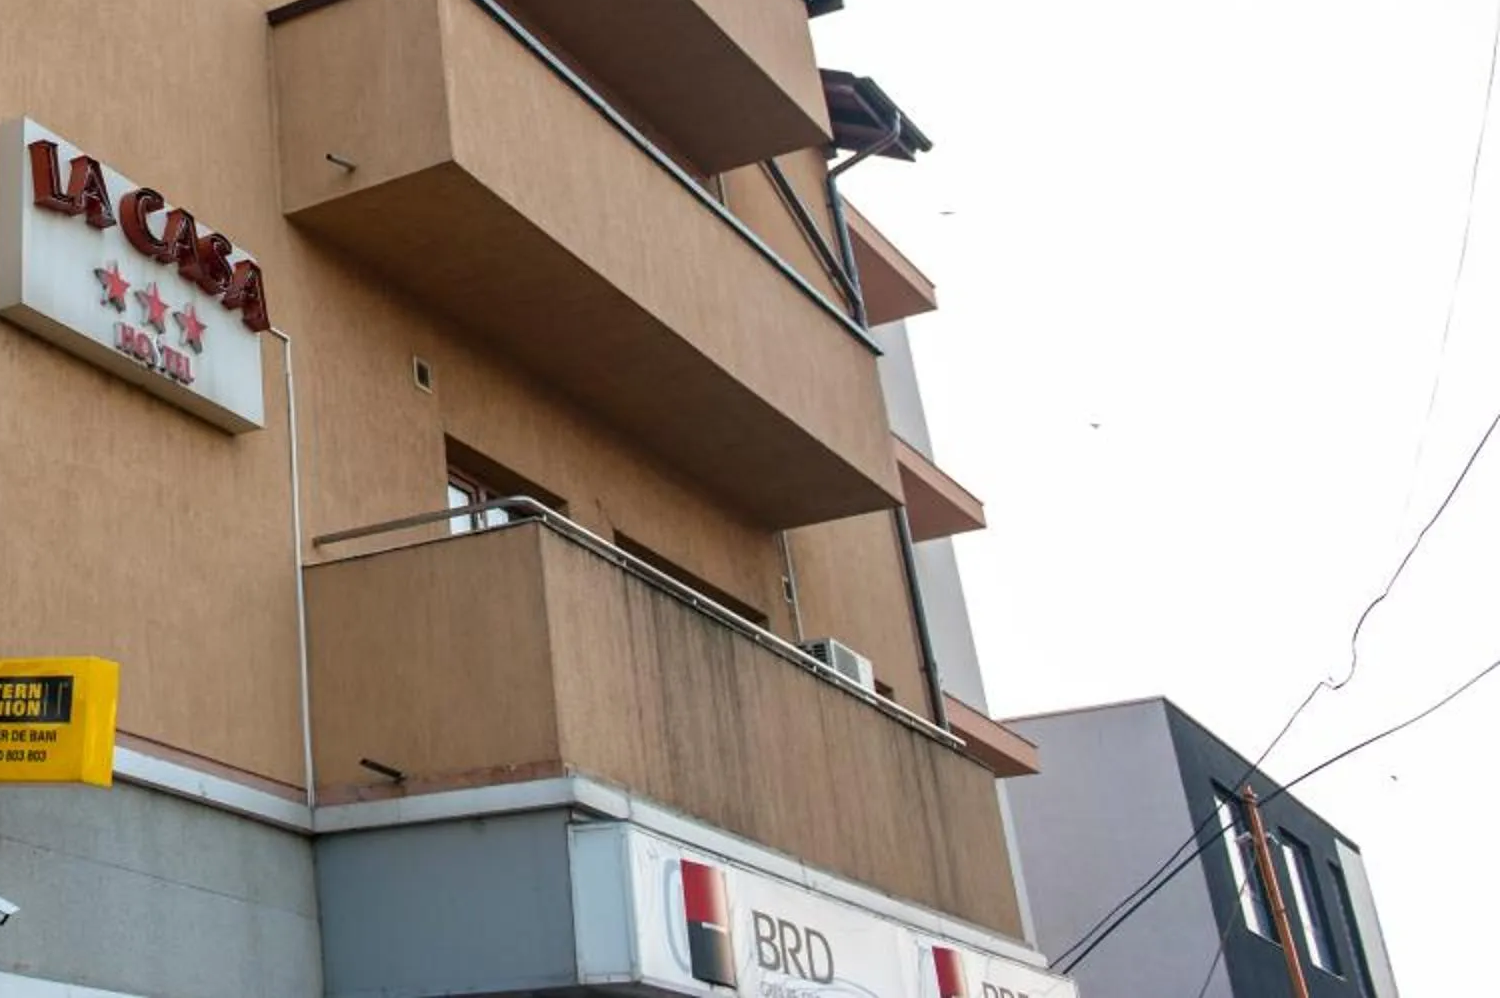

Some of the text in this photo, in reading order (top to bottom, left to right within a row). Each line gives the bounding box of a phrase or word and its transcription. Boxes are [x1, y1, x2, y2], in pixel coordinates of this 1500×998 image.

[28, 139, 271, 333] LA CASA
[11, 729, 26, 742] DE
[29, 729, 57, 742] BANI
[752, 909, 834, 985] BRD
